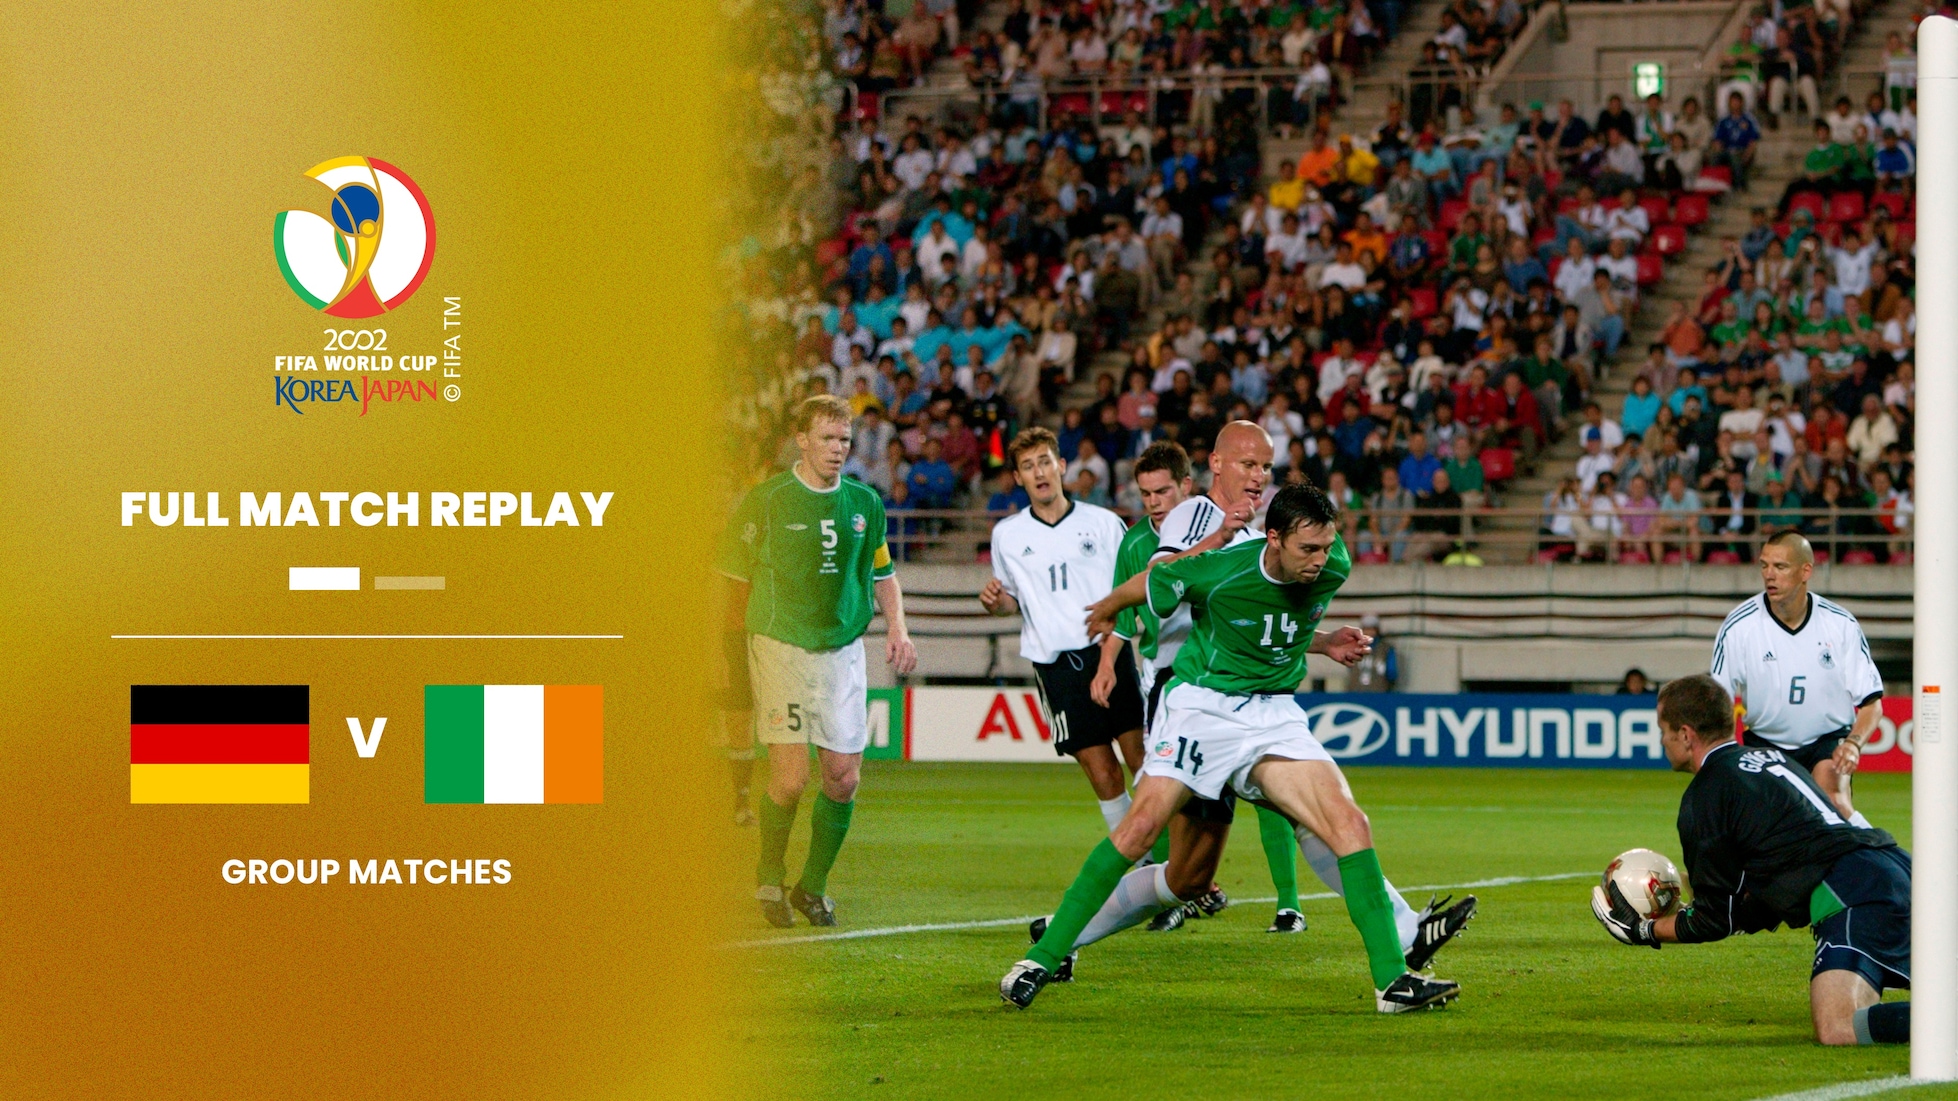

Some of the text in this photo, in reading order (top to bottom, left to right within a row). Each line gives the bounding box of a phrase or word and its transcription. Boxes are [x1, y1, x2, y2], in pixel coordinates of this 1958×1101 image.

[820, 519, 838, 549] 5
[1048, 562, 1067, 592] 11
[1260, 613, 1298, 646] 14
[1788, 675, 1806, 705] 6
[787, 703, 801, 732] 5
[1175, 736, 1203, 776] 14
[1766, 764, 1845, 825] 1
